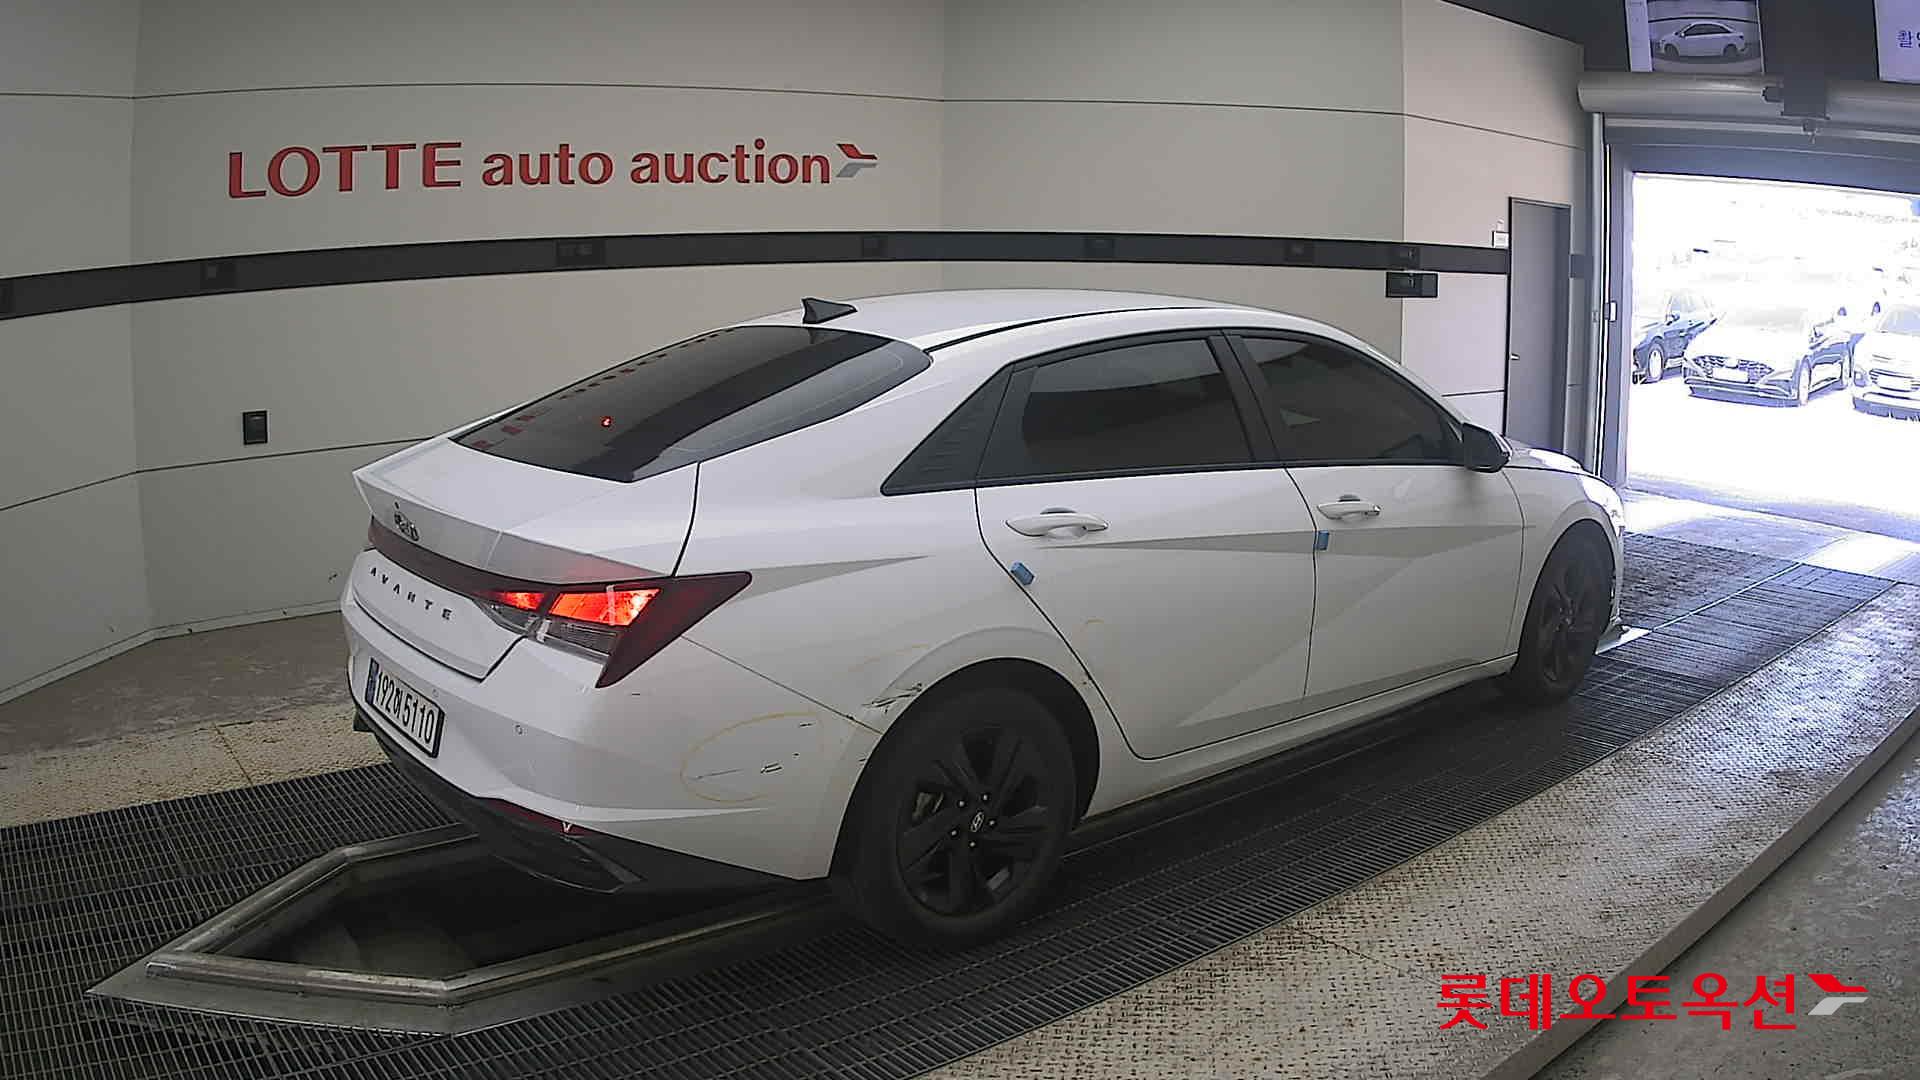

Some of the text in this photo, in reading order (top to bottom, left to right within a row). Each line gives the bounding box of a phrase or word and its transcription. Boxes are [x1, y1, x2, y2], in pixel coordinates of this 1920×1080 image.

[228, 138, 831, 199] LOTTE auto auction
[369, 566, 453, 621] AVANTE
